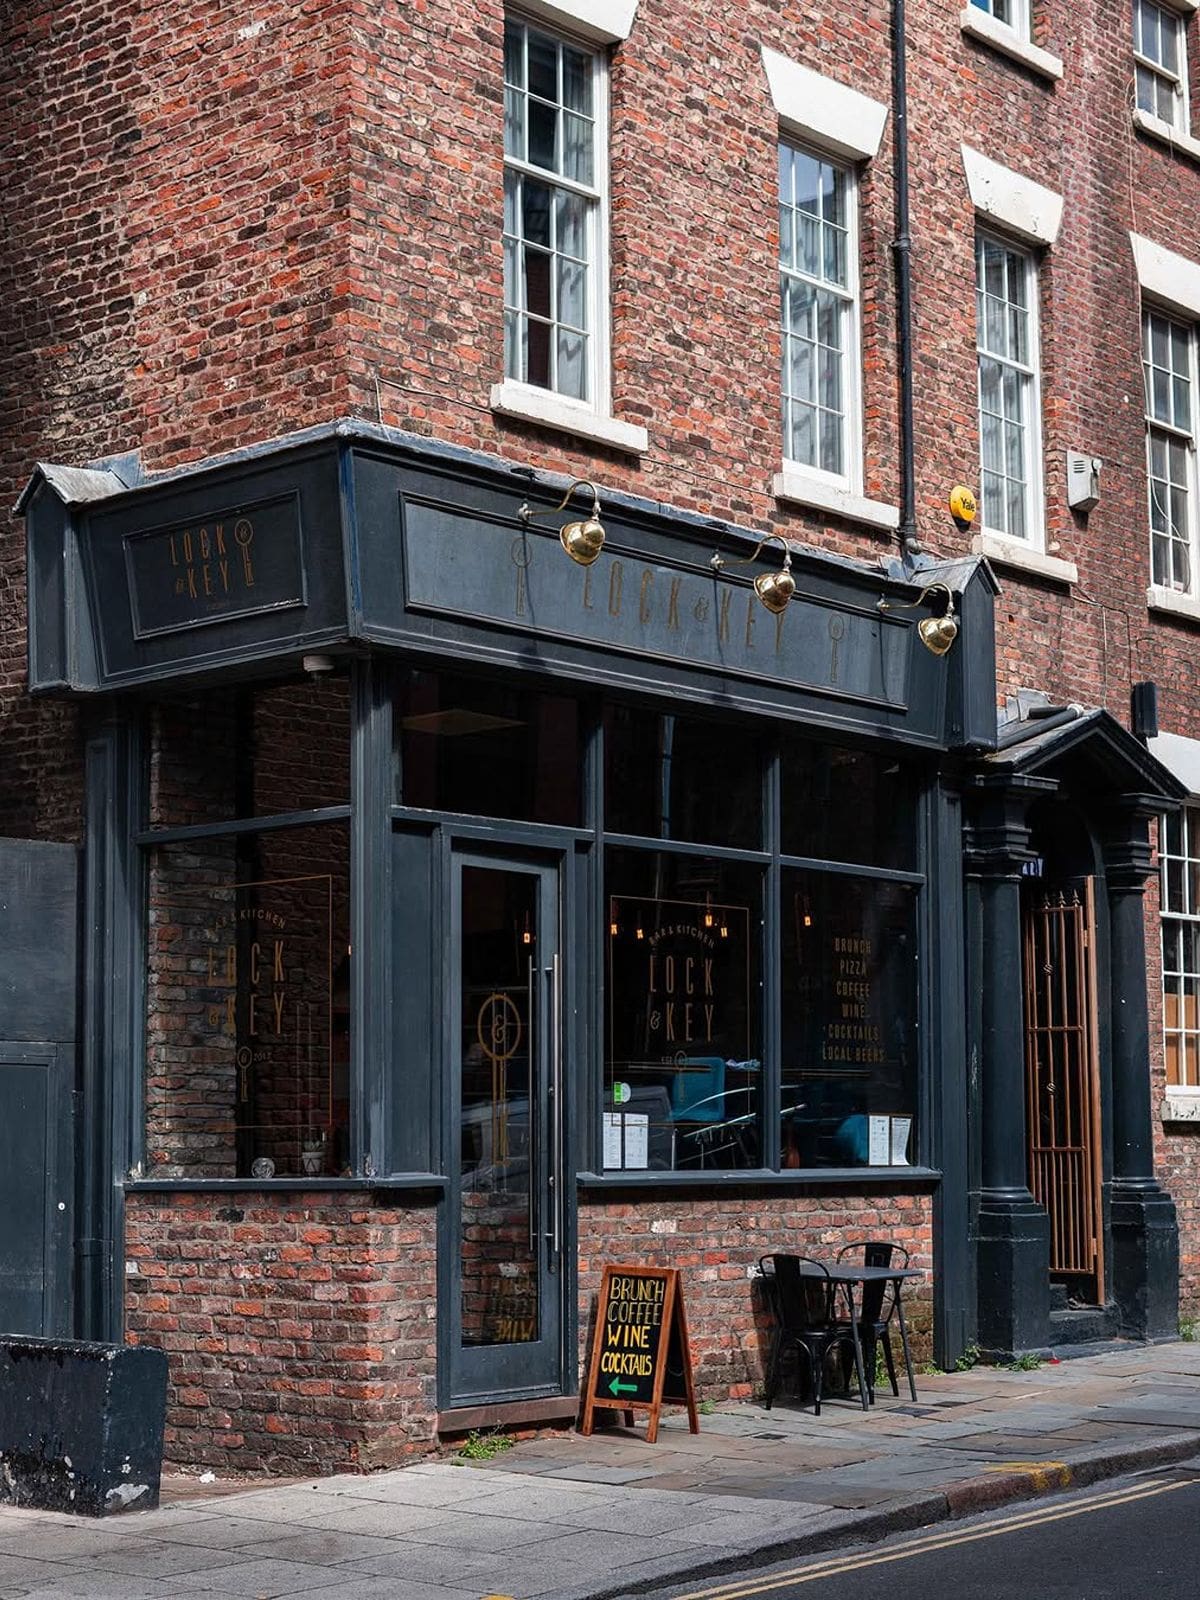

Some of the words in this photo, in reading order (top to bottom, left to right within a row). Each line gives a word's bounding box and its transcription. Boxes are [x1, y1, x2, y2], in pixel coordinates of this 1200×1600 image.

[960, 497, 975, 512] Yale
[170, 522, 226, 566] LOCK
[187, 560, 228, 599] KEY
[584, 561, 683, 633] LOCK
[694, 597, 710, 622] &
[720, 587, 784, 656] KEY
[240, 908, 287, 929] KITCHEN
[676, 925, 715, 950] KITCHEN
[834, 937, 871, 954] BRUNCH
[650, 954, 713, 996] LOCK
[840, 959, 867, 976] PIZZA
[836, 980, 870, 998] COFFEE
[227, 991, 284, 1036] KEY
[650, 1009, 661, 1030] &
[666, 1001, 714, 1042] KEY
[842, 1003, 865, 1019] WINE
[828, 1023, 880, 1041] COCKTAILS
[822, 1045, 852, 1062] LOCAL
[855, 1047, 888, 1063] BEERS
[610, 1277, 665, 1302] BRUNCH
[607, 1301, 662, 1325] COFFEE
[608, 1324, 651, 1348] WINE
[601, 1351, 653, 1376] COCKTAILS
